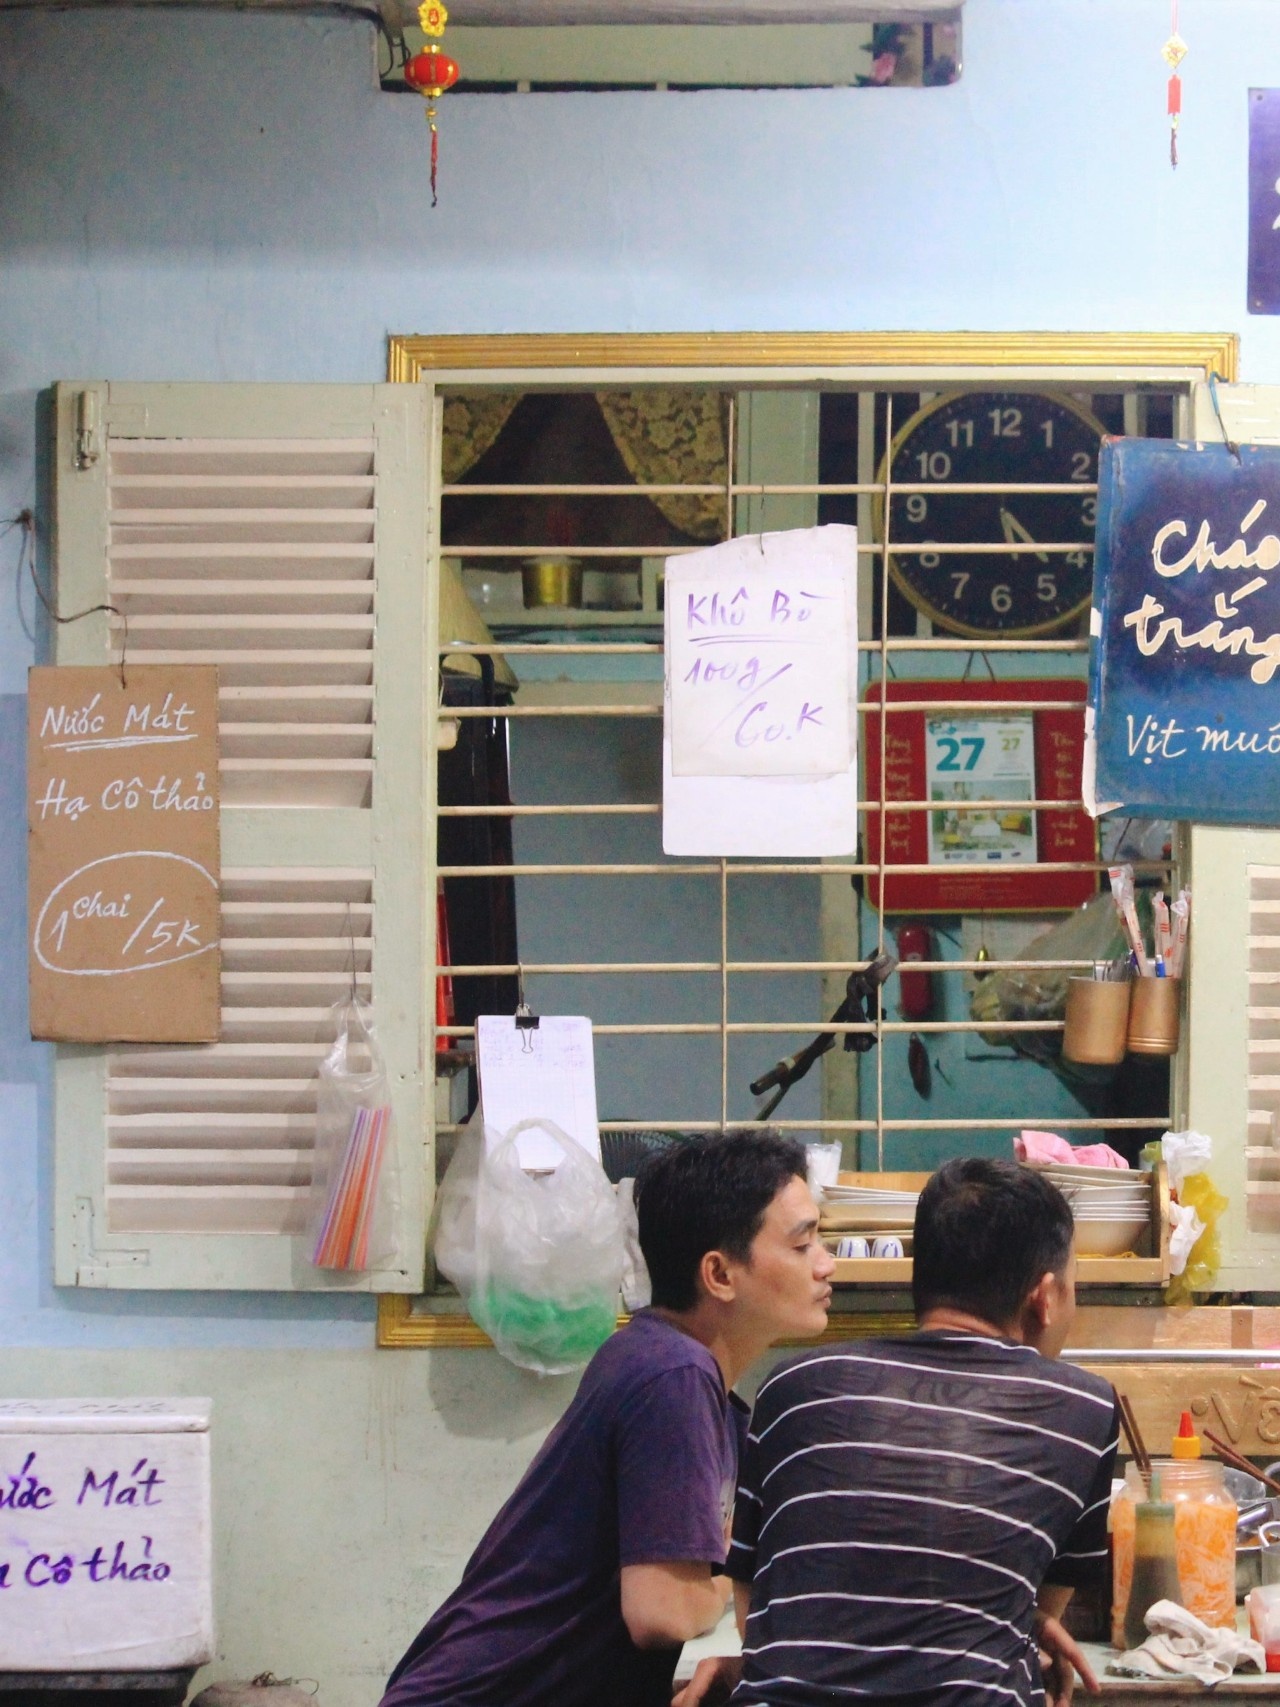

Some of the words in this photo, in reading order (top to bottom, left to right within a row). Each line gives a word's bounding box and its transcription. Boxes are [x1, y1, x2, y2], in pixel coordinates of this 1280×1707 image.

[946, 419, 974, 447] 11
[988, 408, 1023, 437] 12
[1041, 419, 1053, 448] 1
[916, 451, 951, 480] 10
[1071, 452, 1091, 481] 2
[906, 494, 927, 523] 9
[1081, 497, 1097, 527] 3
[951, 572, 970, 600] 7
[991, 585, 1012, 613] 6
[1037, 574, 1057, 601] 5
[687, 586, 749, 630] Khô
[40, 693, 105, 738] Nước
[124, 692, 196, 733] Mát
[1126, 713, 1187, 764] Vịt
[935, 737, 985, 773] 27
[35, 778, 91, 821] Hạ
[101, 776, 144, 811] Cô
[147, 771, 215, 812] thảo
[77, 1458, 165, 1507] Mát
[25, 1553, 75, 1587] Cô
[81, 1535, 171, 1583] thảo
